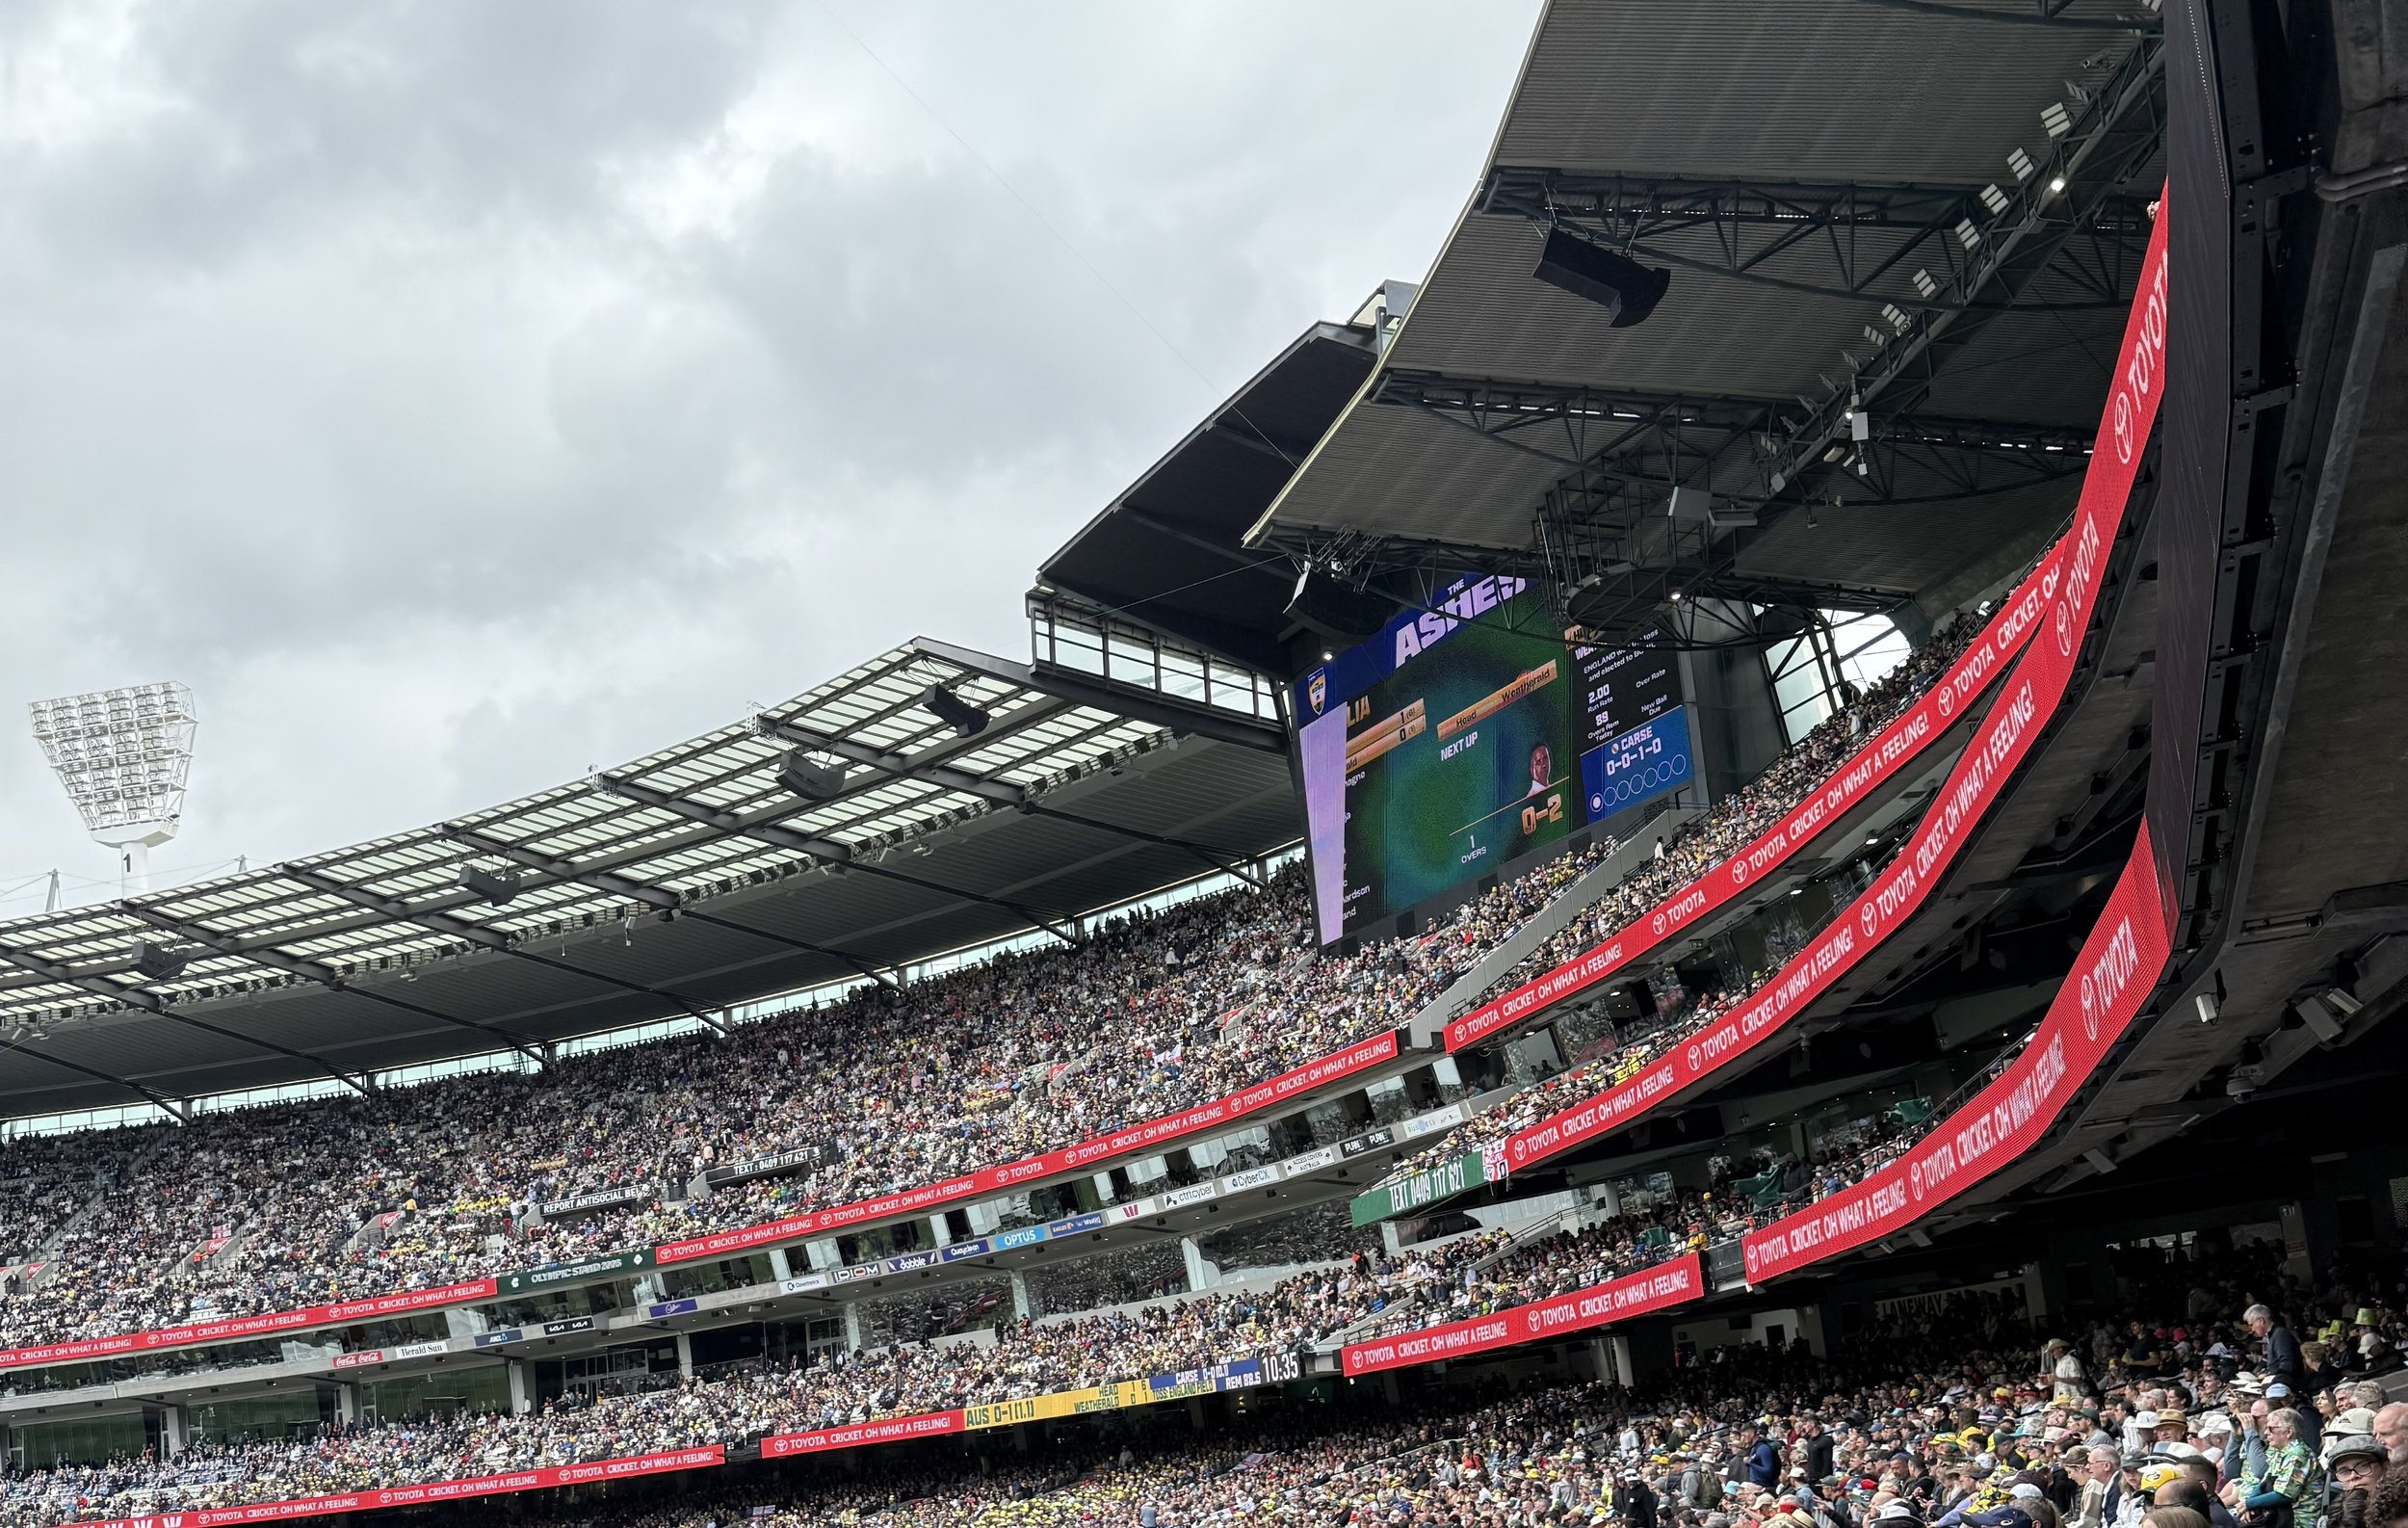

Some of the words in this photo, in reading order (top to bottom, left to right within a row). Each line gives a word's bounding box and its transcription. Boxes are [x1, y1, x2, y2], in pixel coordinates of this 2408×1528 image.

[2066, 511, 2100, 623] TOYOTA
[1448, 578, 1465, 594] THE
[1396, 575, 1527, 669] ASHES
[1953, 643, 1994, 697] TOYOTA
[1997, 588, 2042, 648] CRICKET.
[1584, 650, 1616, 674] ENGLAND
[1588, 670, 1601, 683] and
[1601, 657, 1625, 676] elected
[1625, 651, 1634, 662] to
[1636, 675, 1650, 689] Over
[1651, 669, 1666, 680] Rate
[1587, 683, 1610, 704] 2.00
[1587, 701, 1599, 713] Run
[1599, 696, 1613, 707] Rate
[1640, 701, 1655, 713] New
[1655, 694, 1667, 706] Ball
[1595, 710, 1610, 726] 89
[1648, 705, 1662, 716] Due
[1989, 680, 2034, 760] FEELING!
[1587, 724, 1606, 740] Overs
[1595, 729, 1613, 743] Today
[1621, 725, 1654, 751] CARSE
[1440, 738, 1464, 761] NEXT
[1465, 731, 1479, 748] UP
[1982, 747, 1997, 774] A
[1748, 832, 1786, 870] TOYOTA
[1789, 798, 1827, 839] CRICKET.
[1827, 783, 1843, 808] OH
[1842, 758, 1871, 795] WHAT
[1873, 751, 1882, 772] A
[1881, 711, 1928, 763] FEELING!
[1953, 756, 1988, 813] WHAT
[1520, 792, 1563, 835] 0-2
[1945, 800, 1964, 833] OH
[1470, 834, 1476, 848] 1
[1916, 816, 1950, 877] CRICKET.
[1460, 846, 1487, 863] OVERS
[1875, 865, 1916, 919] TOYOTA
[1666, 889, 1705, 923] TOYOTA
[2093, 914, 2138, 1016] TOYOTA
[1466, 1009, 1499, 1033] TOYOTA
[1502, 989, 1537, 1015] CRICKET.
[1537, 981, 1552, 998] OH
[1552, 966, 1578, 991] WHAT
[1580, 963, 1587, 979] A
[1586, 942, 1622, 973] FEELING!
[1701, 1024, 1739, 1060] TOYOTA
[1741, 996, 1776, 1035] CRICKET.
[1775, 984, 1789, 1011] OH
[1787, 963, 1809, 1000] WHAT
[1810, 959, 1818, 981] A
[1816, 927, 1853, 974] FEELING!
[1242, 1086, 1272, 1106] TOYOTA
[1276, 1072, 1308, 1093] CRICKET.
[1309, 1067, 1322, 1081] OH
[1322, 1057, 1346, 1075] WHAT
[1348, 1054, 1354, 1067] A
[1354, 1040, 1391, 1063] FEELING!
[1526, 1126, 1558, 1152] TOYOTA
[1561, 1108, 1598, 1136] CRICKET.
[1597, 1100, 1612, 1120] OH
[1611, 1087, 1636, 1113] WHAT
[1636, 1084, 1643, 1102] A
[1641, 1064, 1673, 1097] FEELING!
[734, 1164, 754, 1175] TEXT
[759, 1158, 777, 1171] 0409
[778, 1155, 792, 1167] 117
[794, 1151, 809, 1163] 621
[1238, 1168, 1270, 1188] CyberCX
[1388, 1180, 1409, 1213] TEXT
[1410, 1172, 1431, 1205] 0409
[1431, 1166, 1447, 1198] 117
[1448, 1160, 1465, 1193] 621
[543, 1200, 575, 1214] REPORT
[575, 1191, 624, 1208] ANTISOCIAL
[1757, 1234, 1788, 1264] TOYOTA
[1790, 1219, 1823, 1251] CRICKET.
[1823, 1212, 1838, 1239] OH
[1836, 1199, 1864, 1232] WHAT
[1865, 1197, 1874, 1223] A
[1871, 1179, 1906, 1218] FEELING!
[1004, 1229, 1036, 1247] OPTUS
[531, 1266, 572, 1283] OLYMPIC
[900, 1257, 927, 1270] dabble
[342, 1303, 374, 1314] TOYOTA
[378, 1297, 410, 1309] CRICKET.
[411, 1294, 424, 1304] OH
[424, 1290, 446, 1302] WHAT
[447, 1289, 453, 1298] A
[453, 1284, 484, 1296] FEELING!
[1541, 1304, 1576, 1326] TOYOTA
[1579, 1293, 1613, 1317] CRICKET.
[1613, 1288, 1626, 1308] OH
[1625, 1281, 1647, 1304] WHAT
[1648, 1279, 1655, 1298] A
[1654, 1269, 1688, 1295] FEELING!
[401, 1345, 427, 1357] Herald
[427, 1344, 443, 1354] Sun
[1363, 1345, 1395, 1363] TOYOTA
[1398, 1337, 1430, 1357] CRICKET.
[1430, 1334, 1444, 1351] OH
[1444, 1330, 1468, 1348] WHAT
[1470, 1328, 1477, 1343] A
[1476, 1321, 1506, 1341] FEELING!
[1175, 1368, 1199, 1385] CARSE
[1263, 1351, 1299, 1383] 10:35
[1098, 1383, 1118, 1398] HEAD
[1131, 1382, 1136, 1392] 1
[1140, 1379, 1146, 1390] 6
[1169, 1382, 1196, 1398] ENGLAND
[1225, 1375, 1243, 1390] REM
[1073, 1396, 1120, 1413] WEATHERALD
[1130, 1393, 1137, 1405] 0
[1144, 1391, 1148, 1403] 1
[966, 1407, 990, 1427] AUS
[789, 1435, 825, 1448] TOYOTA
[829, 1429, 864, 1443] CRICKET.
[864, 1427, 878, 1438] OH
[878, 1423, 903, 1436] WHAT
[904, 1422, 912, 1433] A
[912, 1416, 950, 1431] FEELING!
